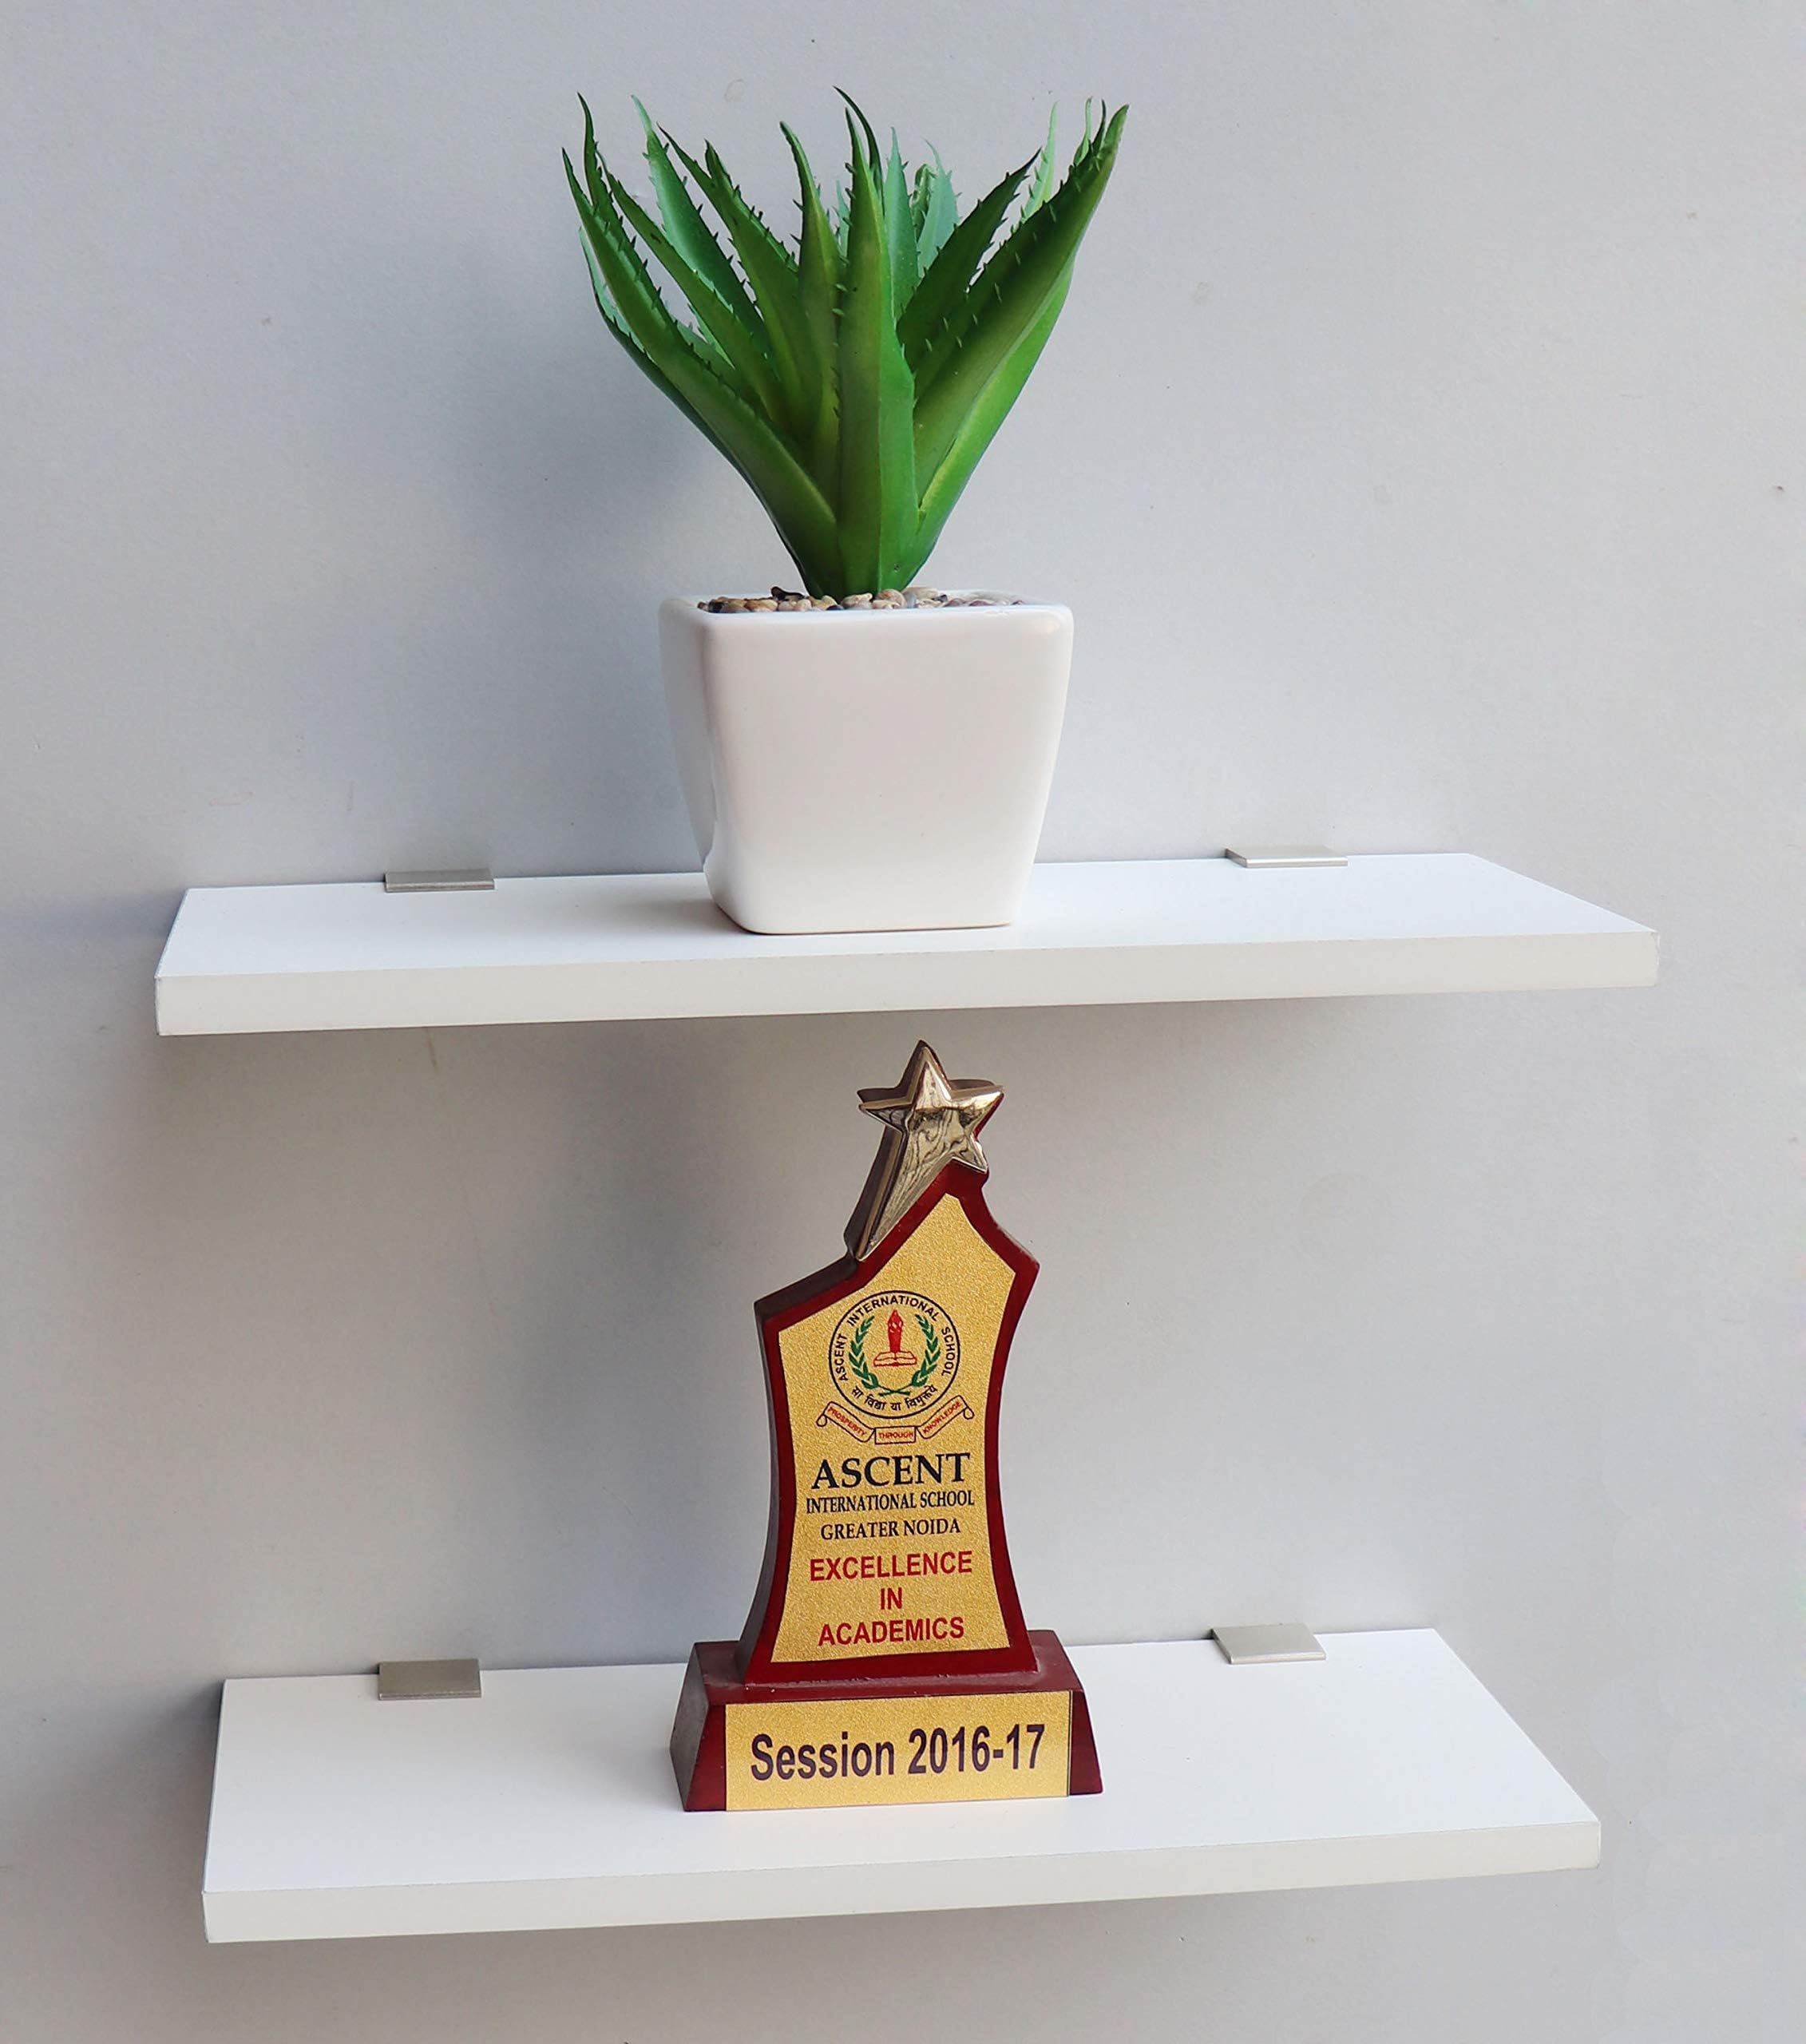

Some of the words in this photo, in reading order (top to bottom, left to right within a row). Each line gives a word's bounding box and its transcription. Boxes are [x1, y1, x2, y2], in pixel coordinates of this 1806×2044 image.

[834, 1334, 848, 1381] ASCENT
[846, 1294, 940, 1327] INTERNATIONAL
[941, 1327, 956, 1377] SCHOOL
[827, 1406, 868, 1437] PROSPERITY
[922, 1400, 962, 1435] KNOWLEDGE
[811, 1452, 971, 1490] ASCENT
[806, 1494, 917, 1514] INTERNATIONAL
[921, 1490, 975, 1508] SCHOOL
[821, 1521, 899, 1540] GREATER
[904, 1518, 960, 1536] NOIDA
[810, 1551, 972, 1582] EXCELLENCE
[880, 1587, 903, 1610] IN
[818, 1617, 964, 1646] ACADEMICS
[751, 1731, 894, 1781] Session
[908, 1724, 1046, 1775] 2016-17
